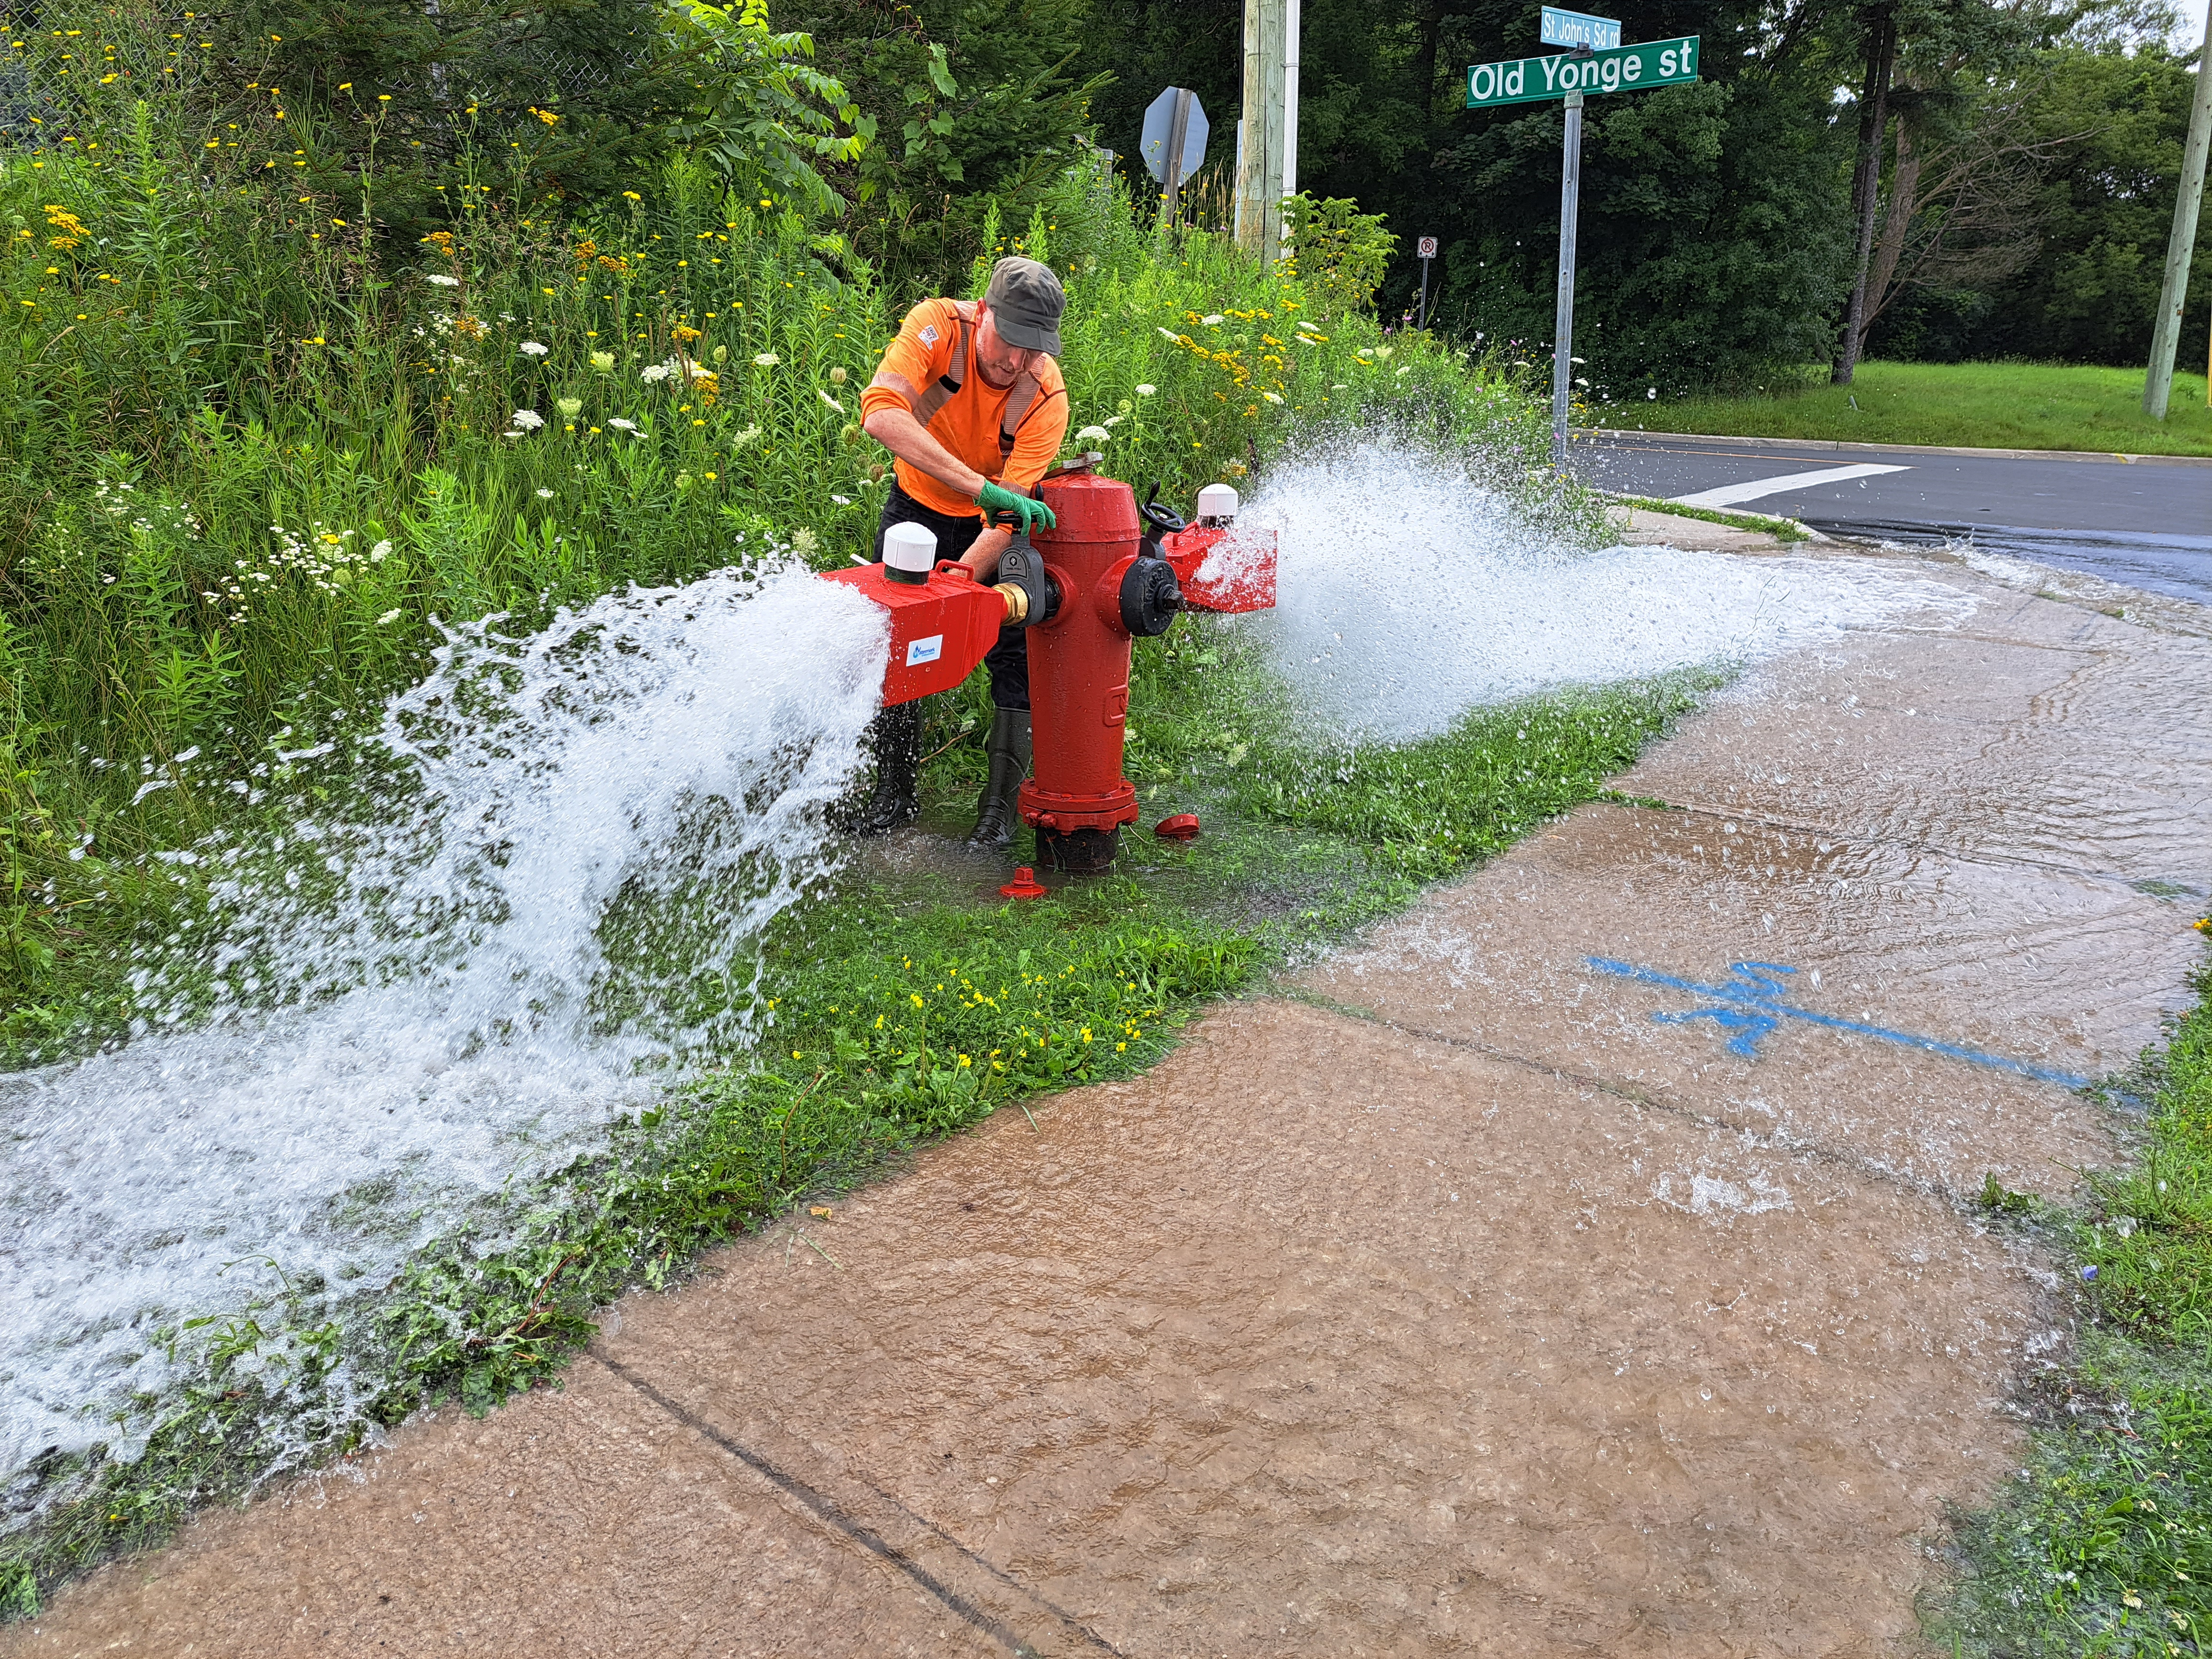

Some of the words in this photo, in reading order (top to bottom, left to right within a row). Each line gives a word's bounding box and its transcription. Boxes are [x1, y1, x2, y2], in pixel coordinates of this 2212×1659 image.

[1544, 12, 1555, 38] St
[1559, 16, 1590, 43] John's
[1594, 22, 1606, 46] Sd
[1610, 26, 1619, 47] rd
[1471, 61, 1525, 100] Old
[1540, 55, 1642, 92] Yonge
[1659, 40, 1692, 77] st
